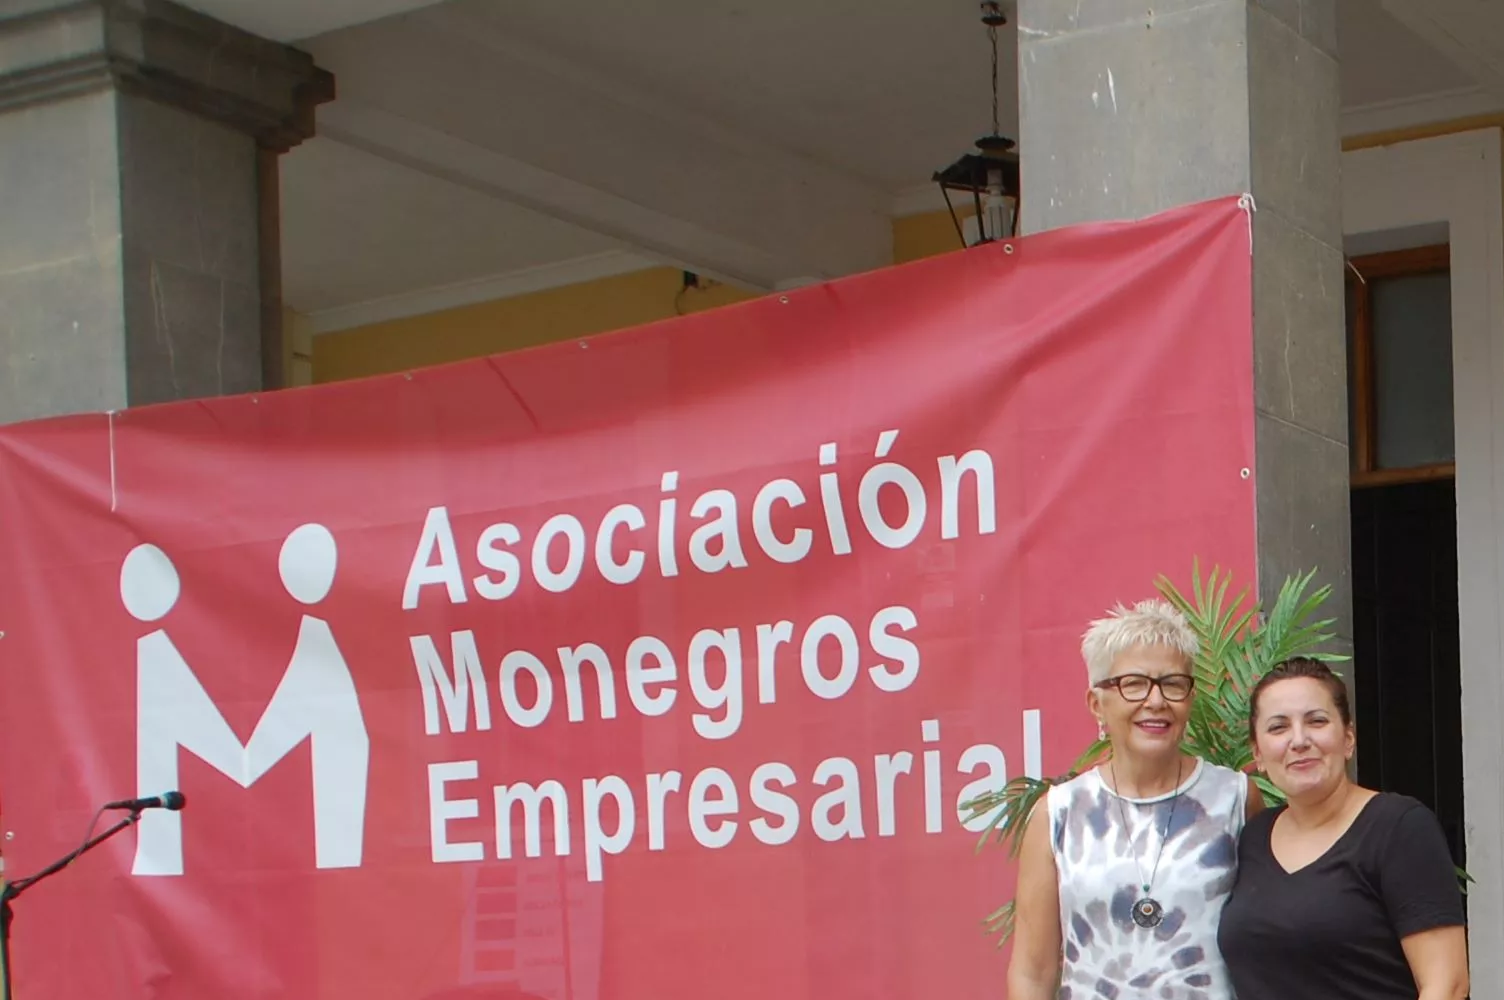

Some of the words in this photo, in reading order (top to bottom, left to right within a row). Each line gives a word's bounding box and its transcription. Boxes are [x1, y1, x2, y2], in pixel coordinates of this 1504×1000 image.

[402, 429, 996, 610] Asociación
[409, 606, 920, 740] Monegros
[427, 708, 1043, 882] Empresarial
